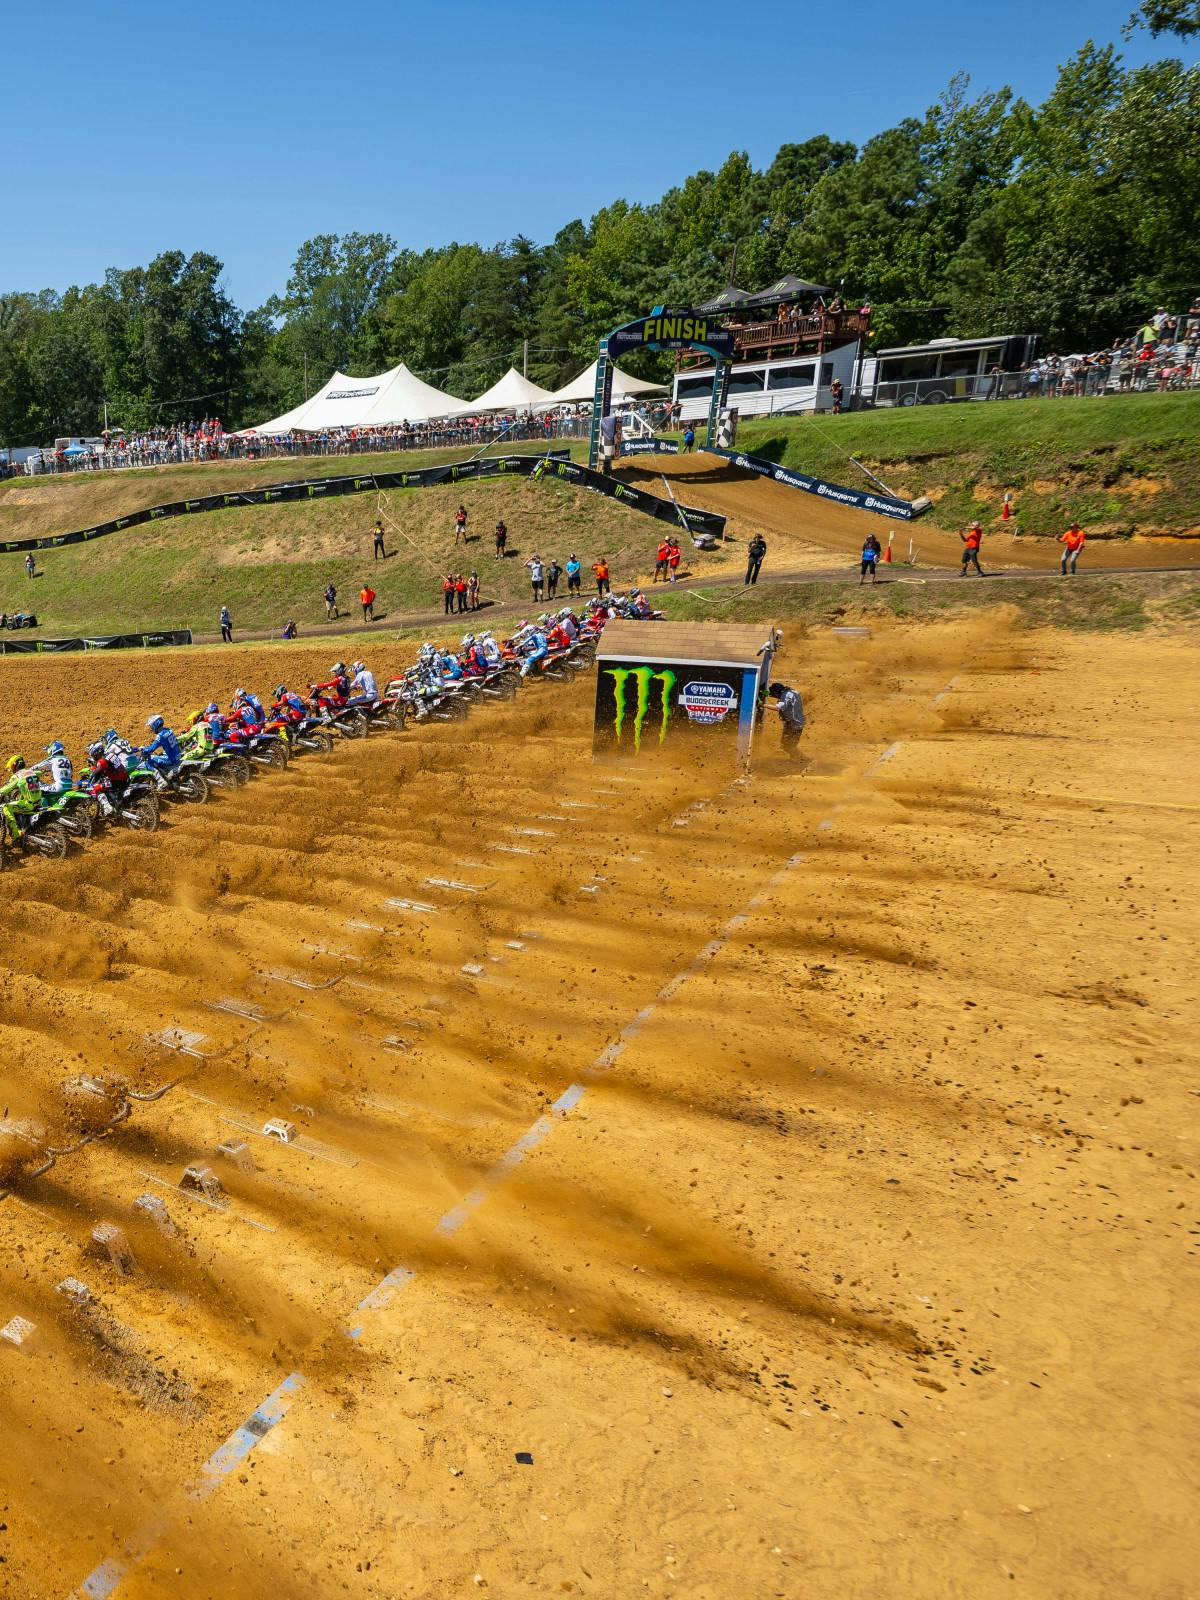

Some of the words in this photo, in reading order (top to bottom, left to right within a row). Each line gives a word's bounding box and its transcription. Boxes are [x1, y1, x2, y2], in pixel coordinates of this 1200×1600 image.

[643, 318, 707, 342] FINISH
[782, 473, 812, 490] Husqvarna
[825, 488, 859, 503] Husqvarna
[699, 685, 726, 694] YAMAHA
[690, 711, 724, 719] FINALS
[57, 758, 70, 769] 26
